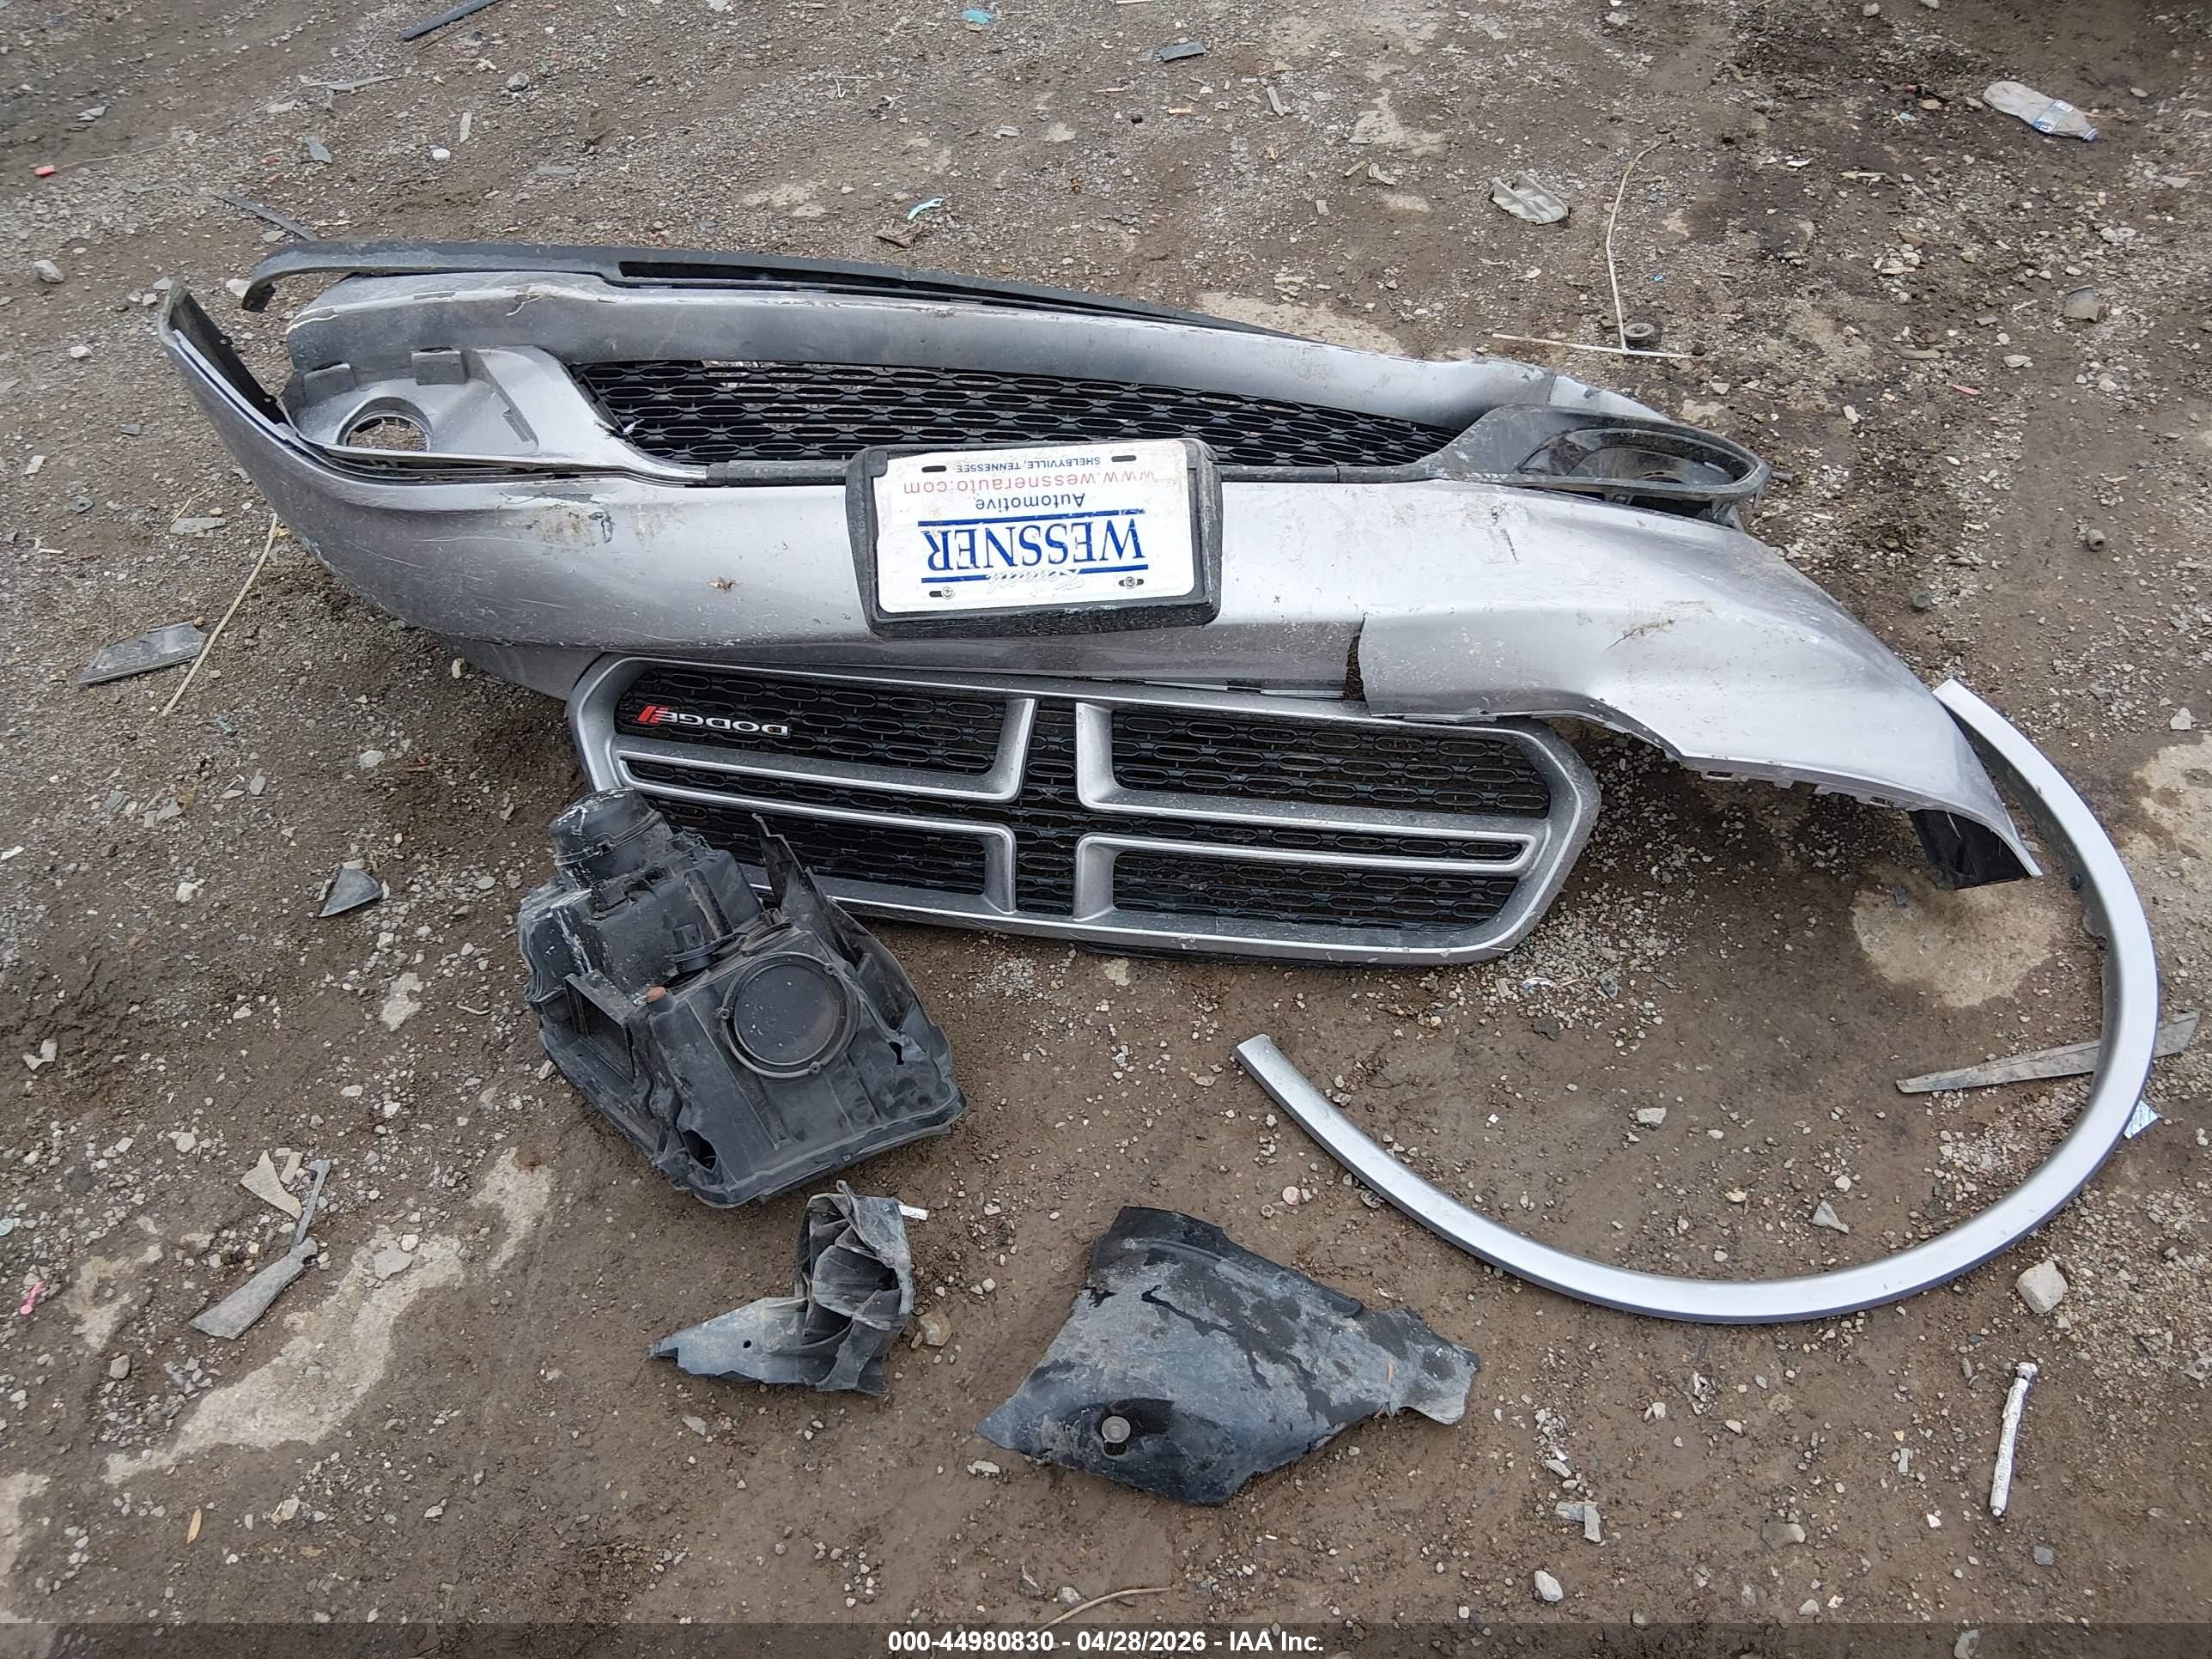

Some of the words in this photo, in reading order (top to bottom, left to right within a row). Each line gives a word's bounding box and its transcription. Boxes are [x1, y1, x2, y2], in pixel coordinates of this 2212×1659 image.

[956, 461, 1021, 473] TENNESSEE
[903, 471, 1154, 496] www.wessnerauto.com
[975, 492, 1085, 513] Automotive
[921, 518, 1146, 572] WESSNER
[654, 709, 788, 736] DODGE
